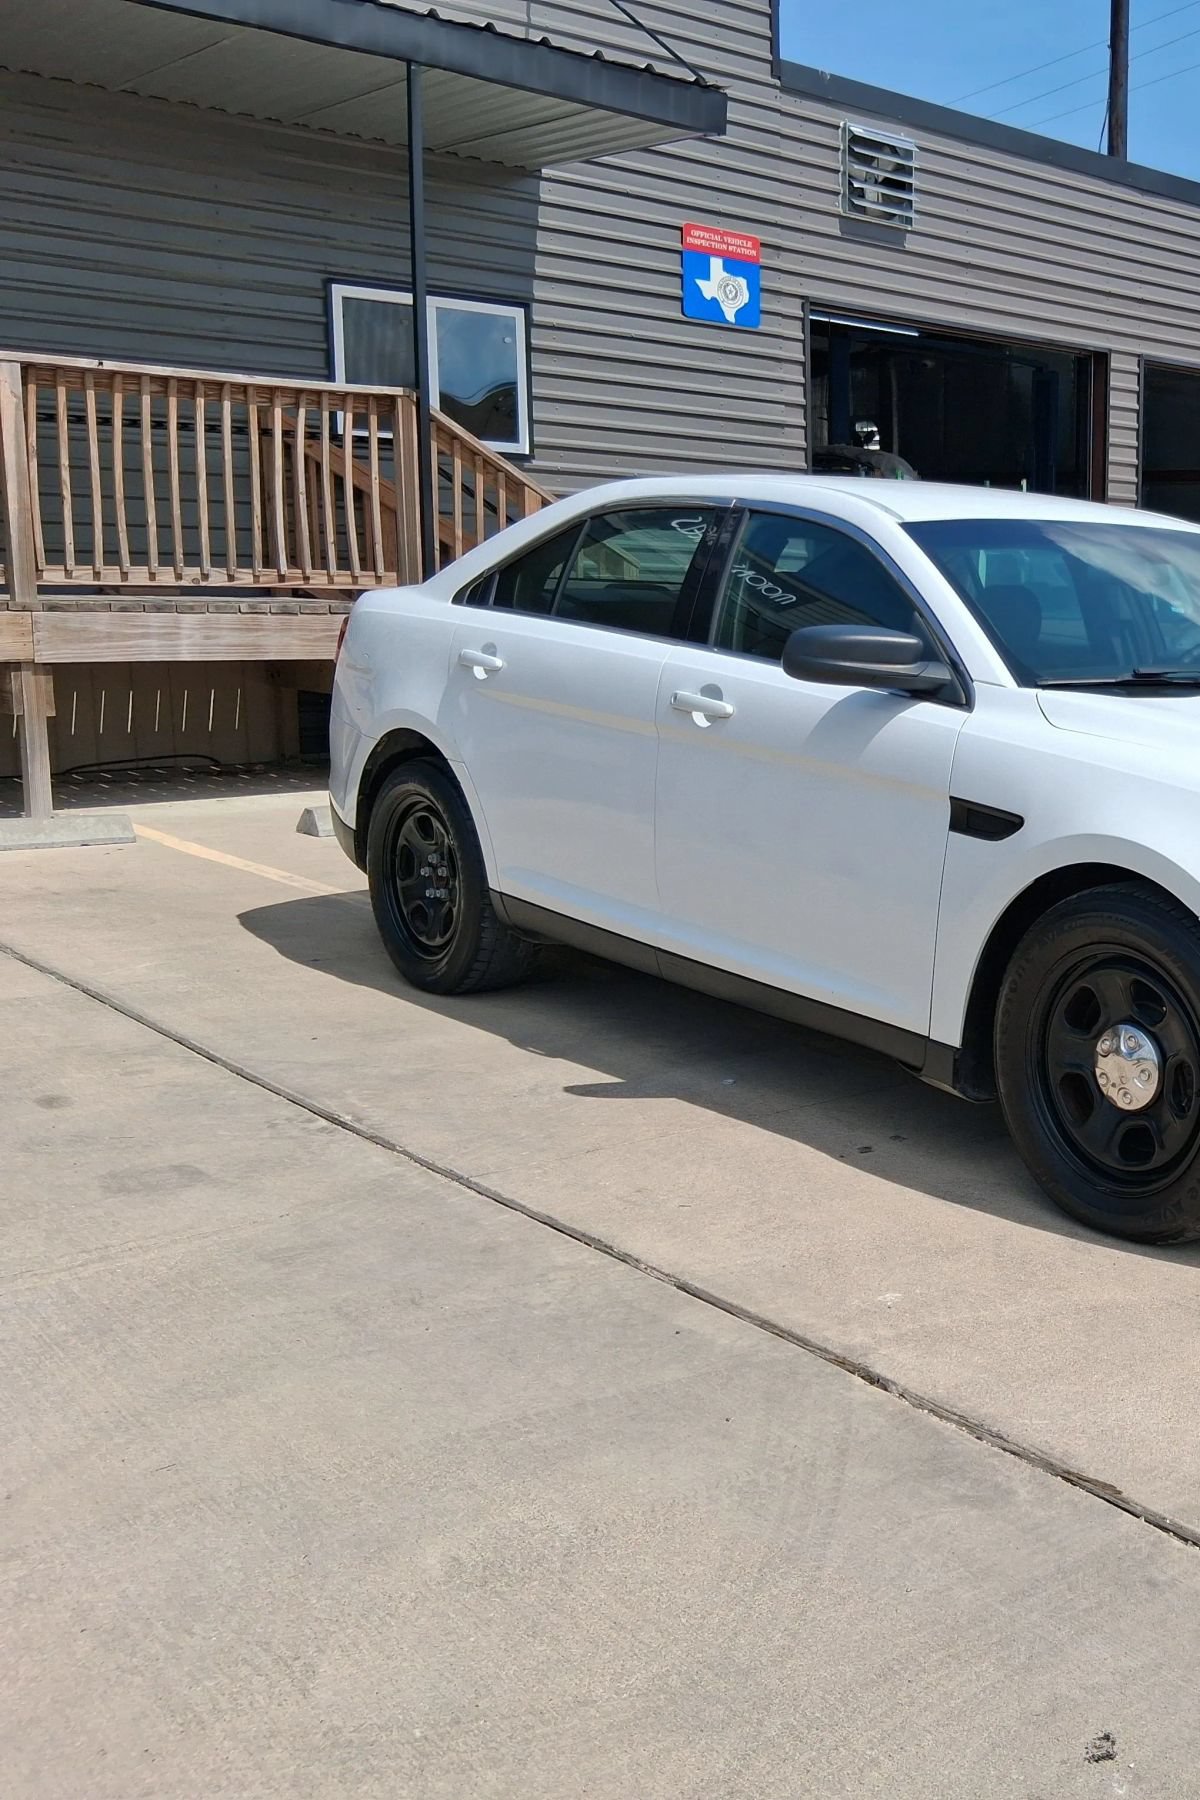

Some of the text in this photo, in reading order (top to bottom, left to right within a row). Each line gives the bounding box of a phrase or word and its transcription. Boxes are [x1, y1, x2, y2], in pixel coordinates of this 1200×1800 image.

[687, 236, 756, 257] INSPECTION STATION
[691, 230, 752, 248] OFFICIAL VEHICLE
